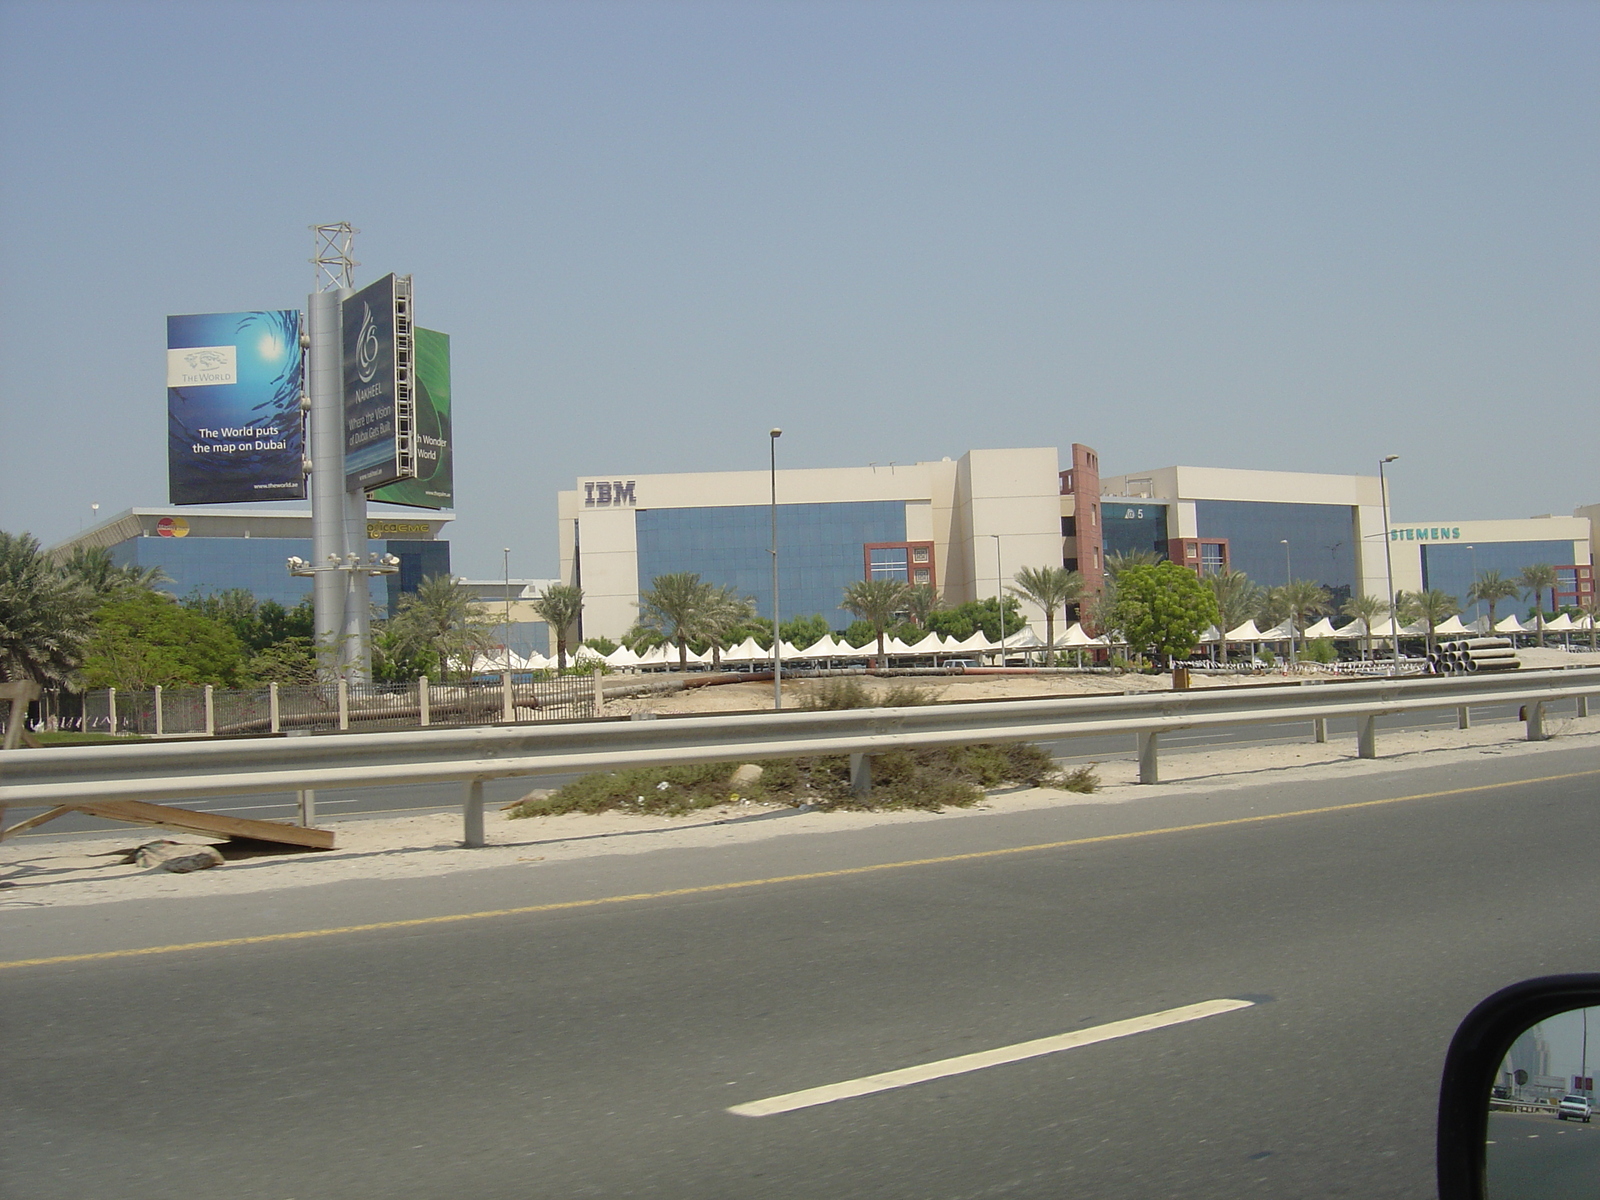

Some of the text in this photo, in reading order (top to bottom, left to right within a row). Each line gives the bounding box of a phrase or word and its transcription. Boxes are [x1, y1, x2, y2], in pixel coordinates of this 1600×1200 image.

[348, 405, 391, 431] Where the Vision
[199, 426, 279, 438] The World puts
[355, 430, 368, 444] Dubai
[369, 427, 379, 439] Gets
[380, 421, 391, 434] Built
[192, 439, 286, 454] the map on Dubai
[423, 434, 447, 447] Wonder
[417, 449, 437, 460] World
[585, 481, 637, 503] IBM
[1138, 509, 1144, 519] 5
[1391, 528, 1460, 540] SIEMENS
